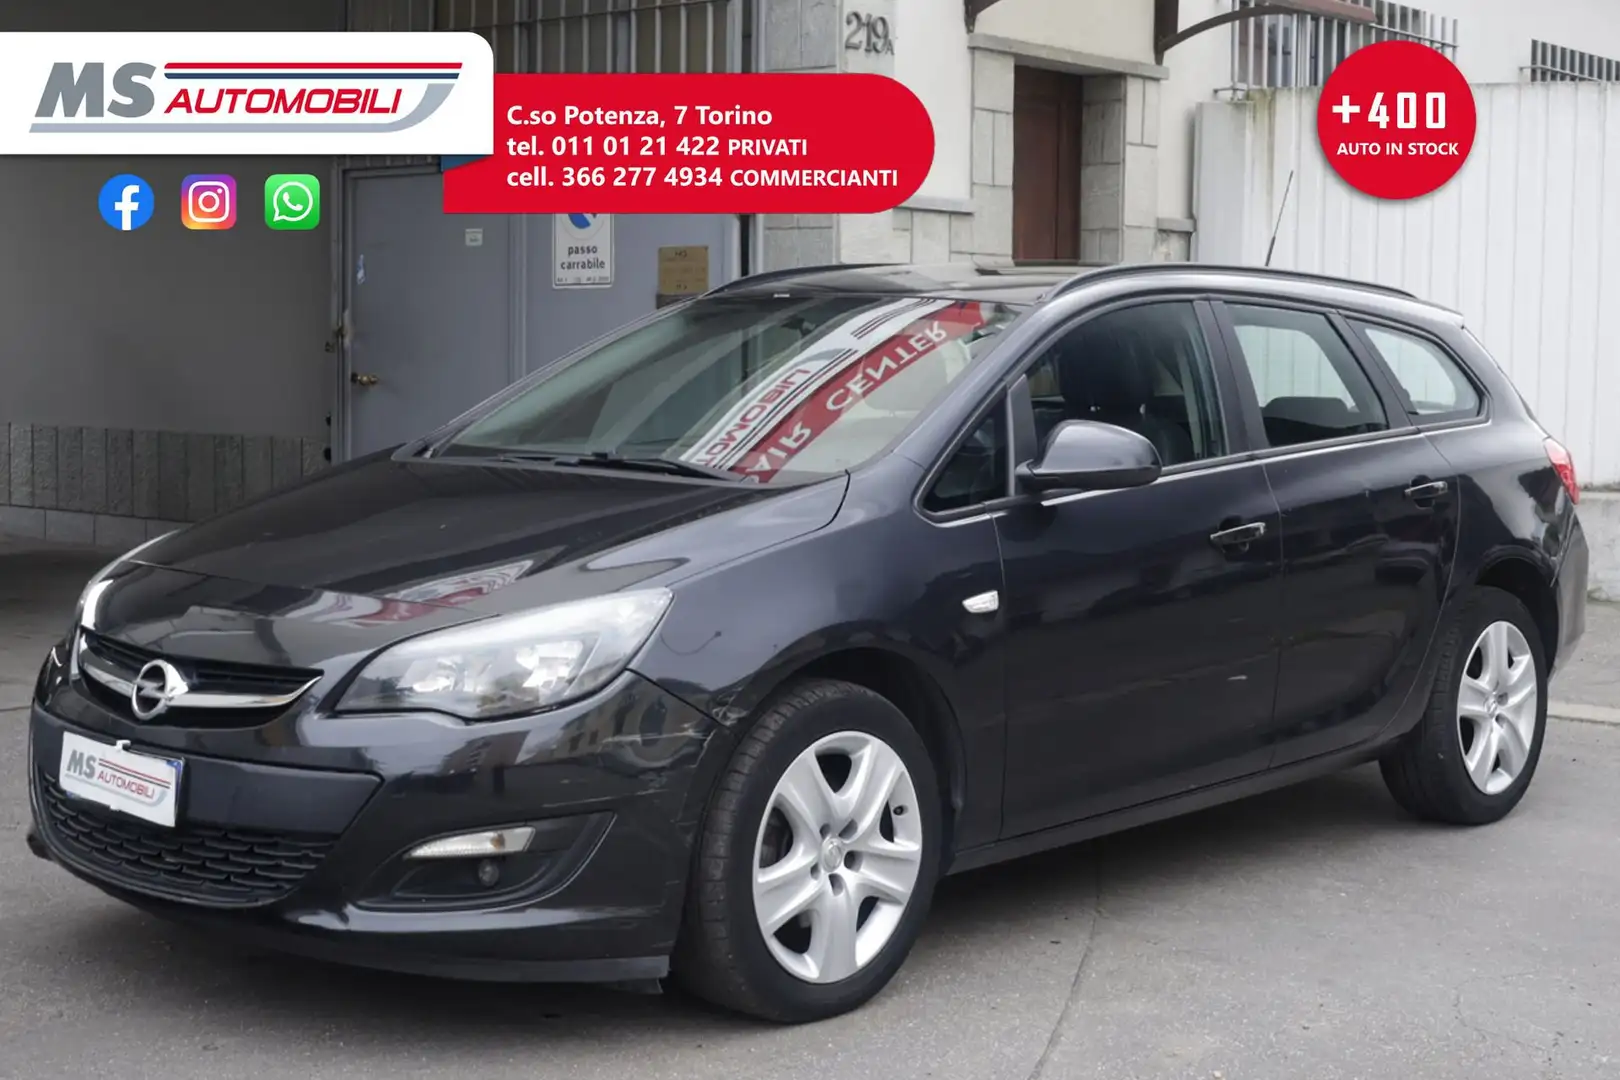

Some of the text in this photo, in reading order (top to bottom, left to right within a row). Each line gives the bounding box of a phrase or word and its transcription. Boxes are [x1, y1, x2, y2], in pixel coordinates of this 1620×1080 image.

[567, 245, 598, 257] passo
[560, 258, 606, 270] carrabile
[66, 748, 155, 800] MS AUTOMOBILI
